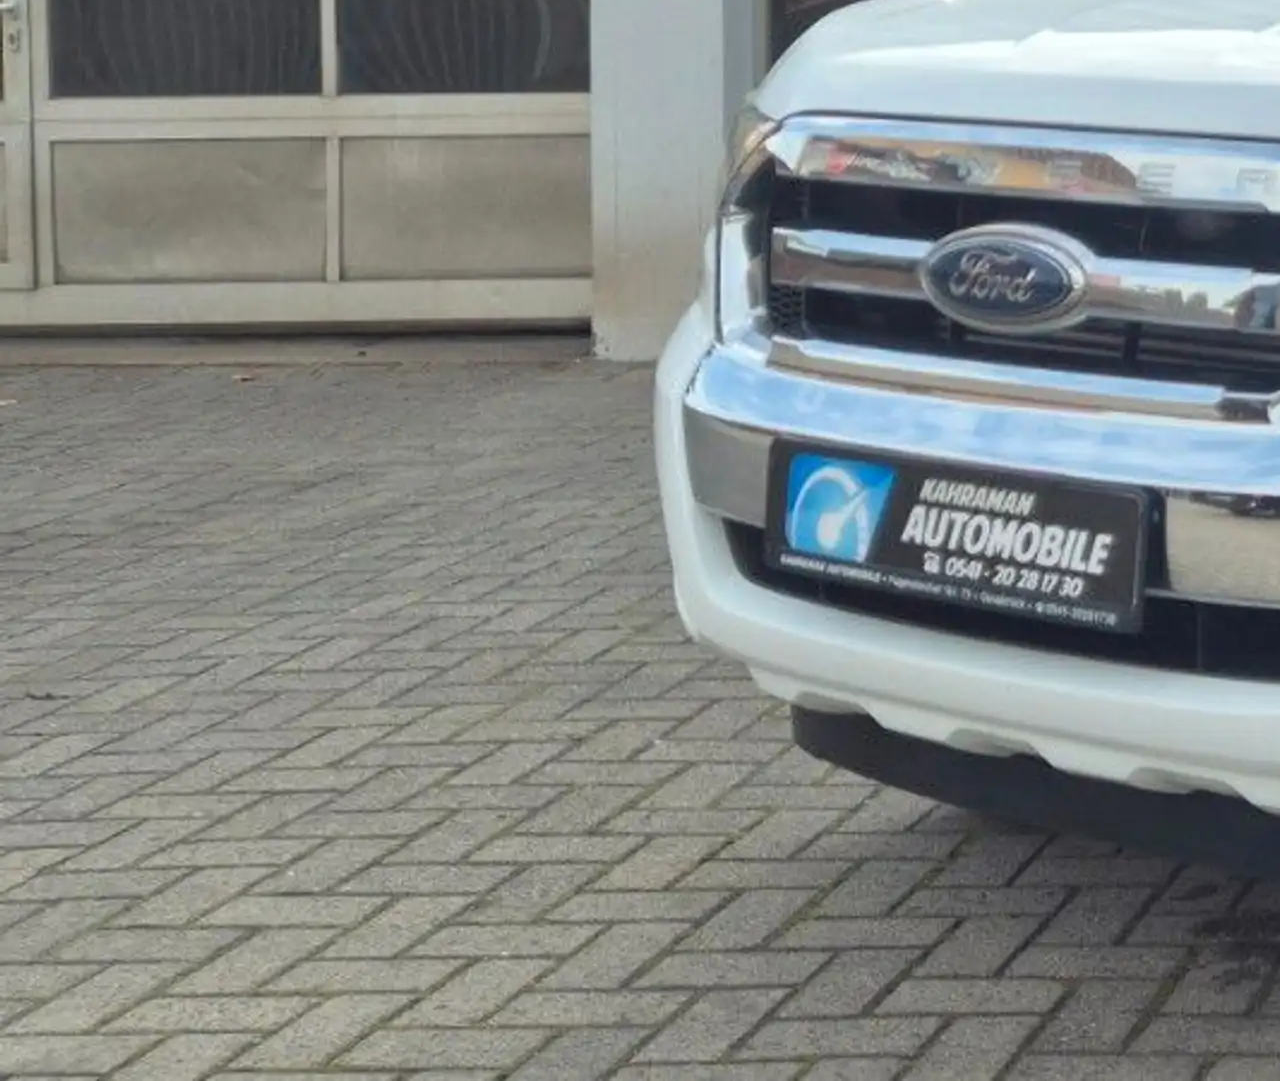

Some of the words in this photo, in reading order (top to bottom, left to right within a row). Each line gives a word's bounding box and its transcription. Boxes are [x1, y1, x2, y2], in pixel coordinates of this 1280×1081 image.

[950, 248, 1038, 303] Ford
[919, 478, 1036, 516] KAHRAMAN
[901, 504, 1113, 575] AUTOMOBILE
[945, 558, 983, 579] 0541
[992, 564, 1015, 586] 20
[1016, 569, 1039, 591] 28
[1040, 574, 1059, 594] 17
[1059, 576, 1085, 597] 30
